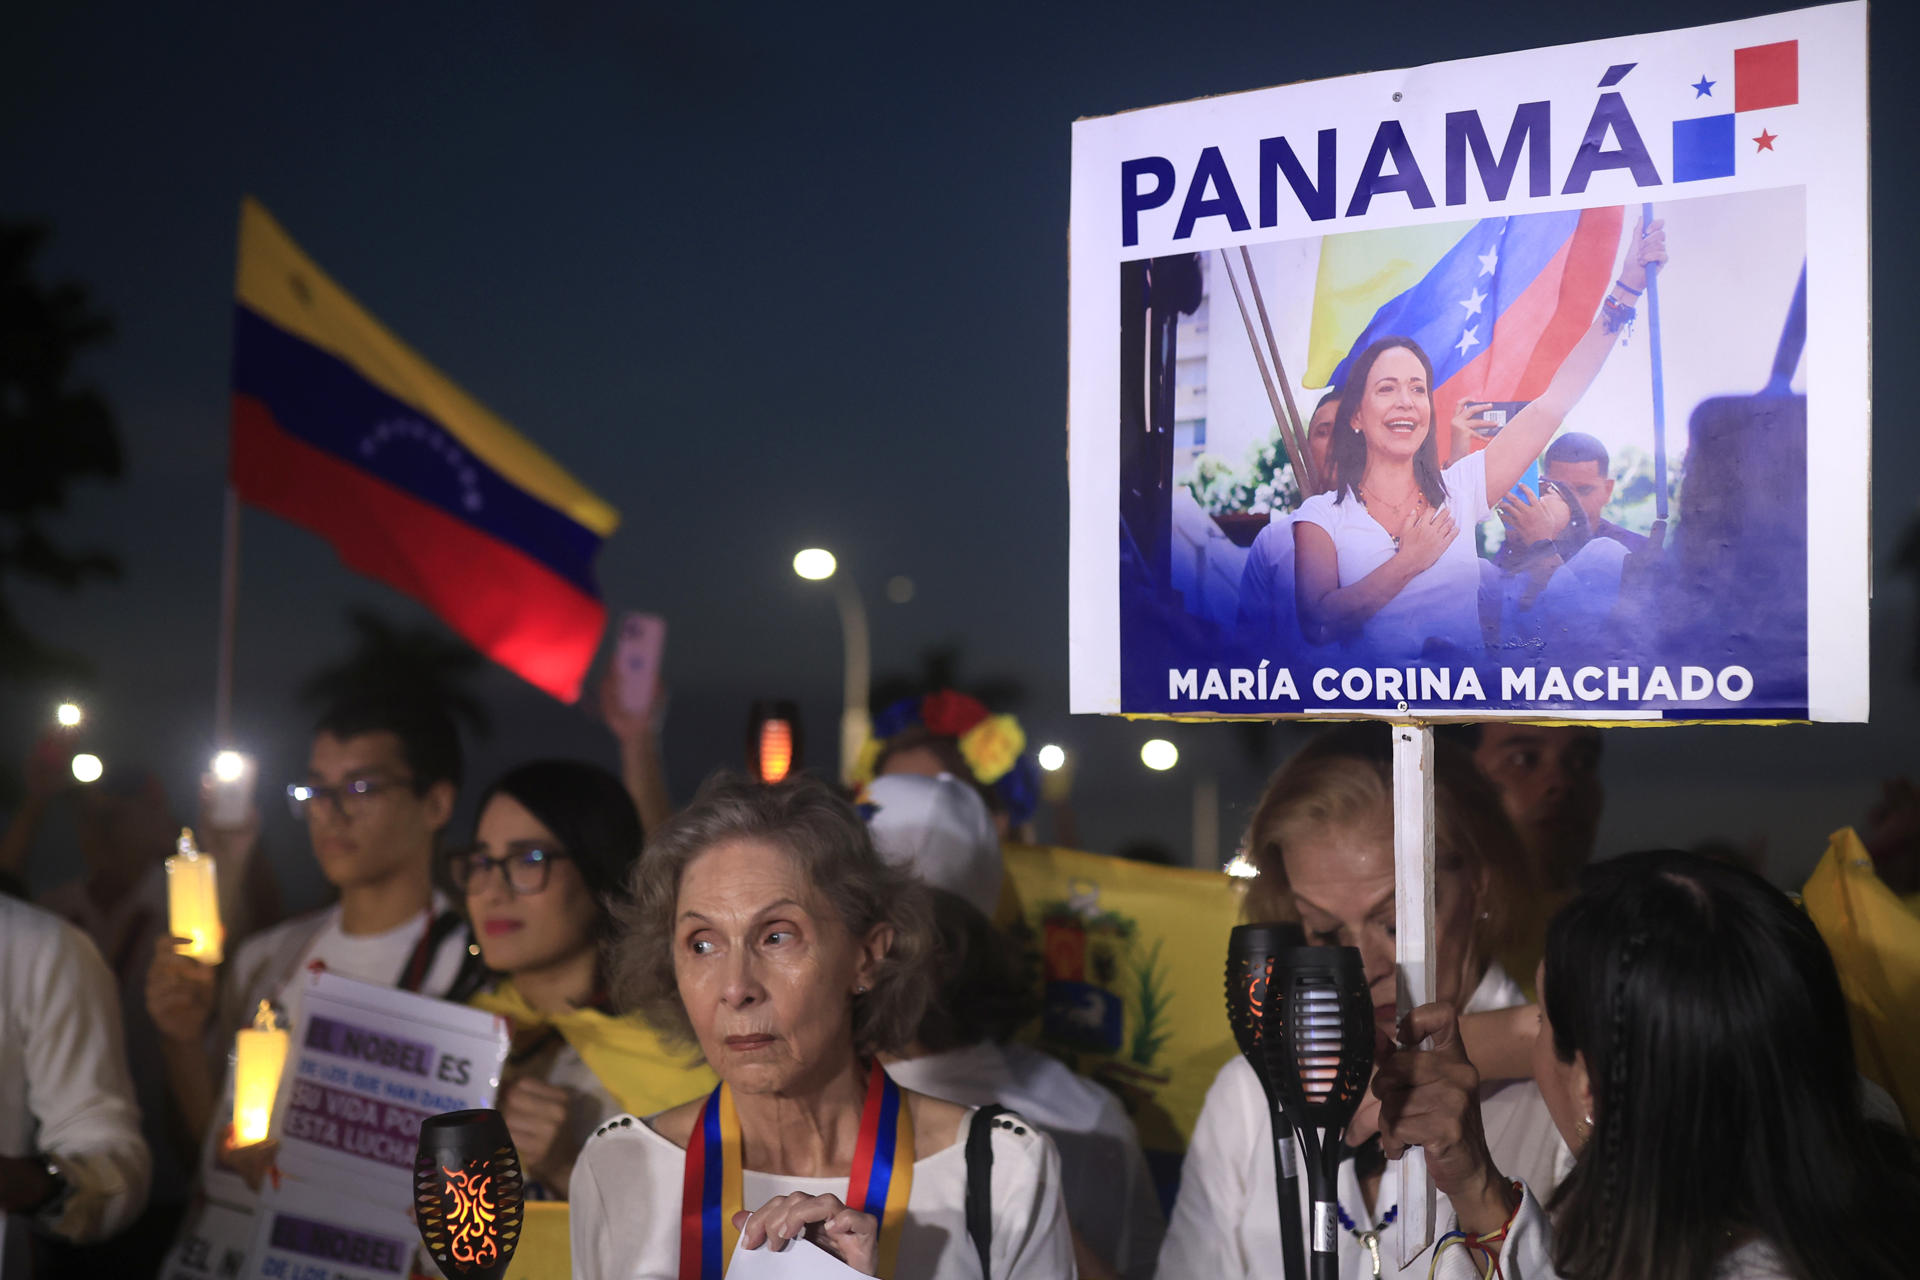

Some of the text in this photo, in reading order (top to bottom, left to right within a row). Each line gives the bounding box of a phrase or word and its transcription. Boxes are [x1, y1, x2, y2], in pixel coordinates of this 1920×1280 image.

[1121, 62, 1663, 248] PANAMÁ
[1168, 658, 1753, 701] MARÍA CORINA MACHADO
[342, 1028, 430, 1077] NOBEL
[436, 1053, 472, 1087] ES
[286, 1110, 339, 1145] ESTA
[325, 1092, 380, 1126] VIDA
